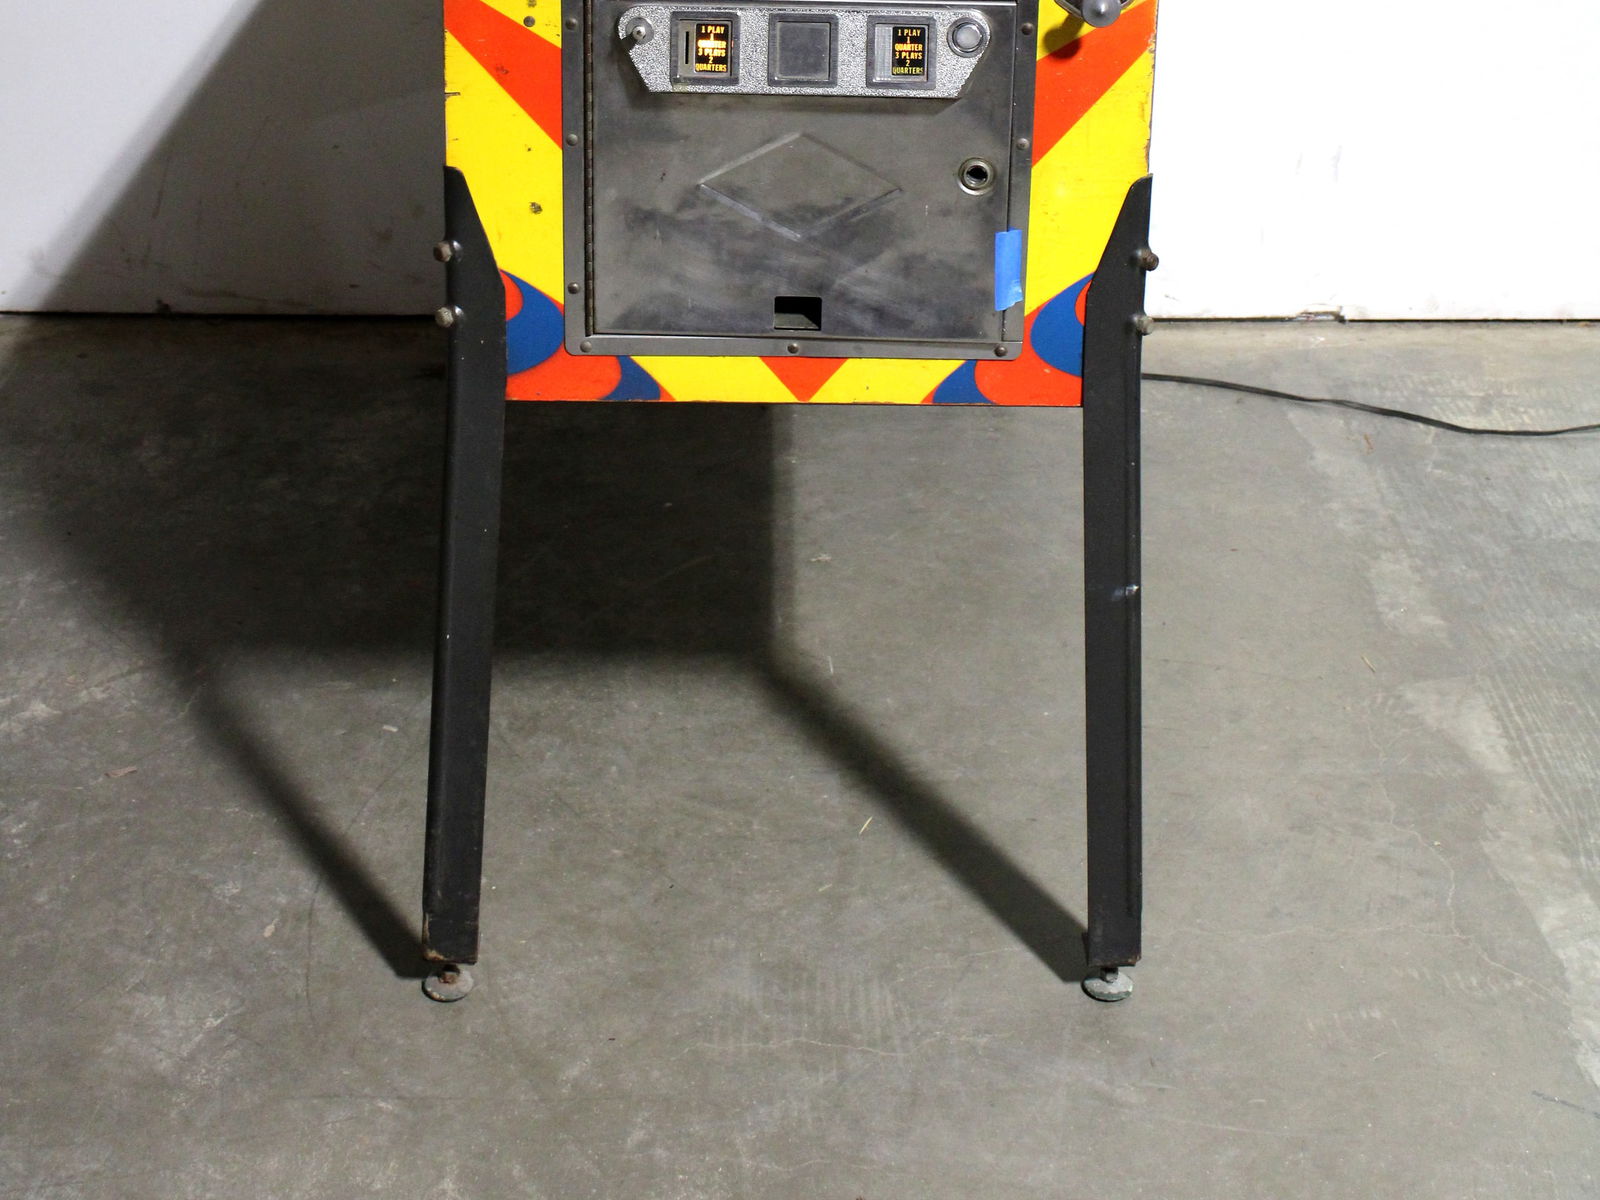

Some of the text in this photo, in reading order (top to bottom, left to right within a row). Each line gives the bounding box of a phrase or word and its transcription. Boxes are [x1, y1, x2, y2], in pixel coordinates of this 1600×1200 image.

[707, 25, 725, 34] PLAY
[895, 43, 923, 51] QUARTER
[704, 48, 726, 57] PLAYS
[901, 51, 923, 59] PLAYS
[695, 63, 727, 72] QUARTERS
[892, 67, 923, 75] QUARTERS
